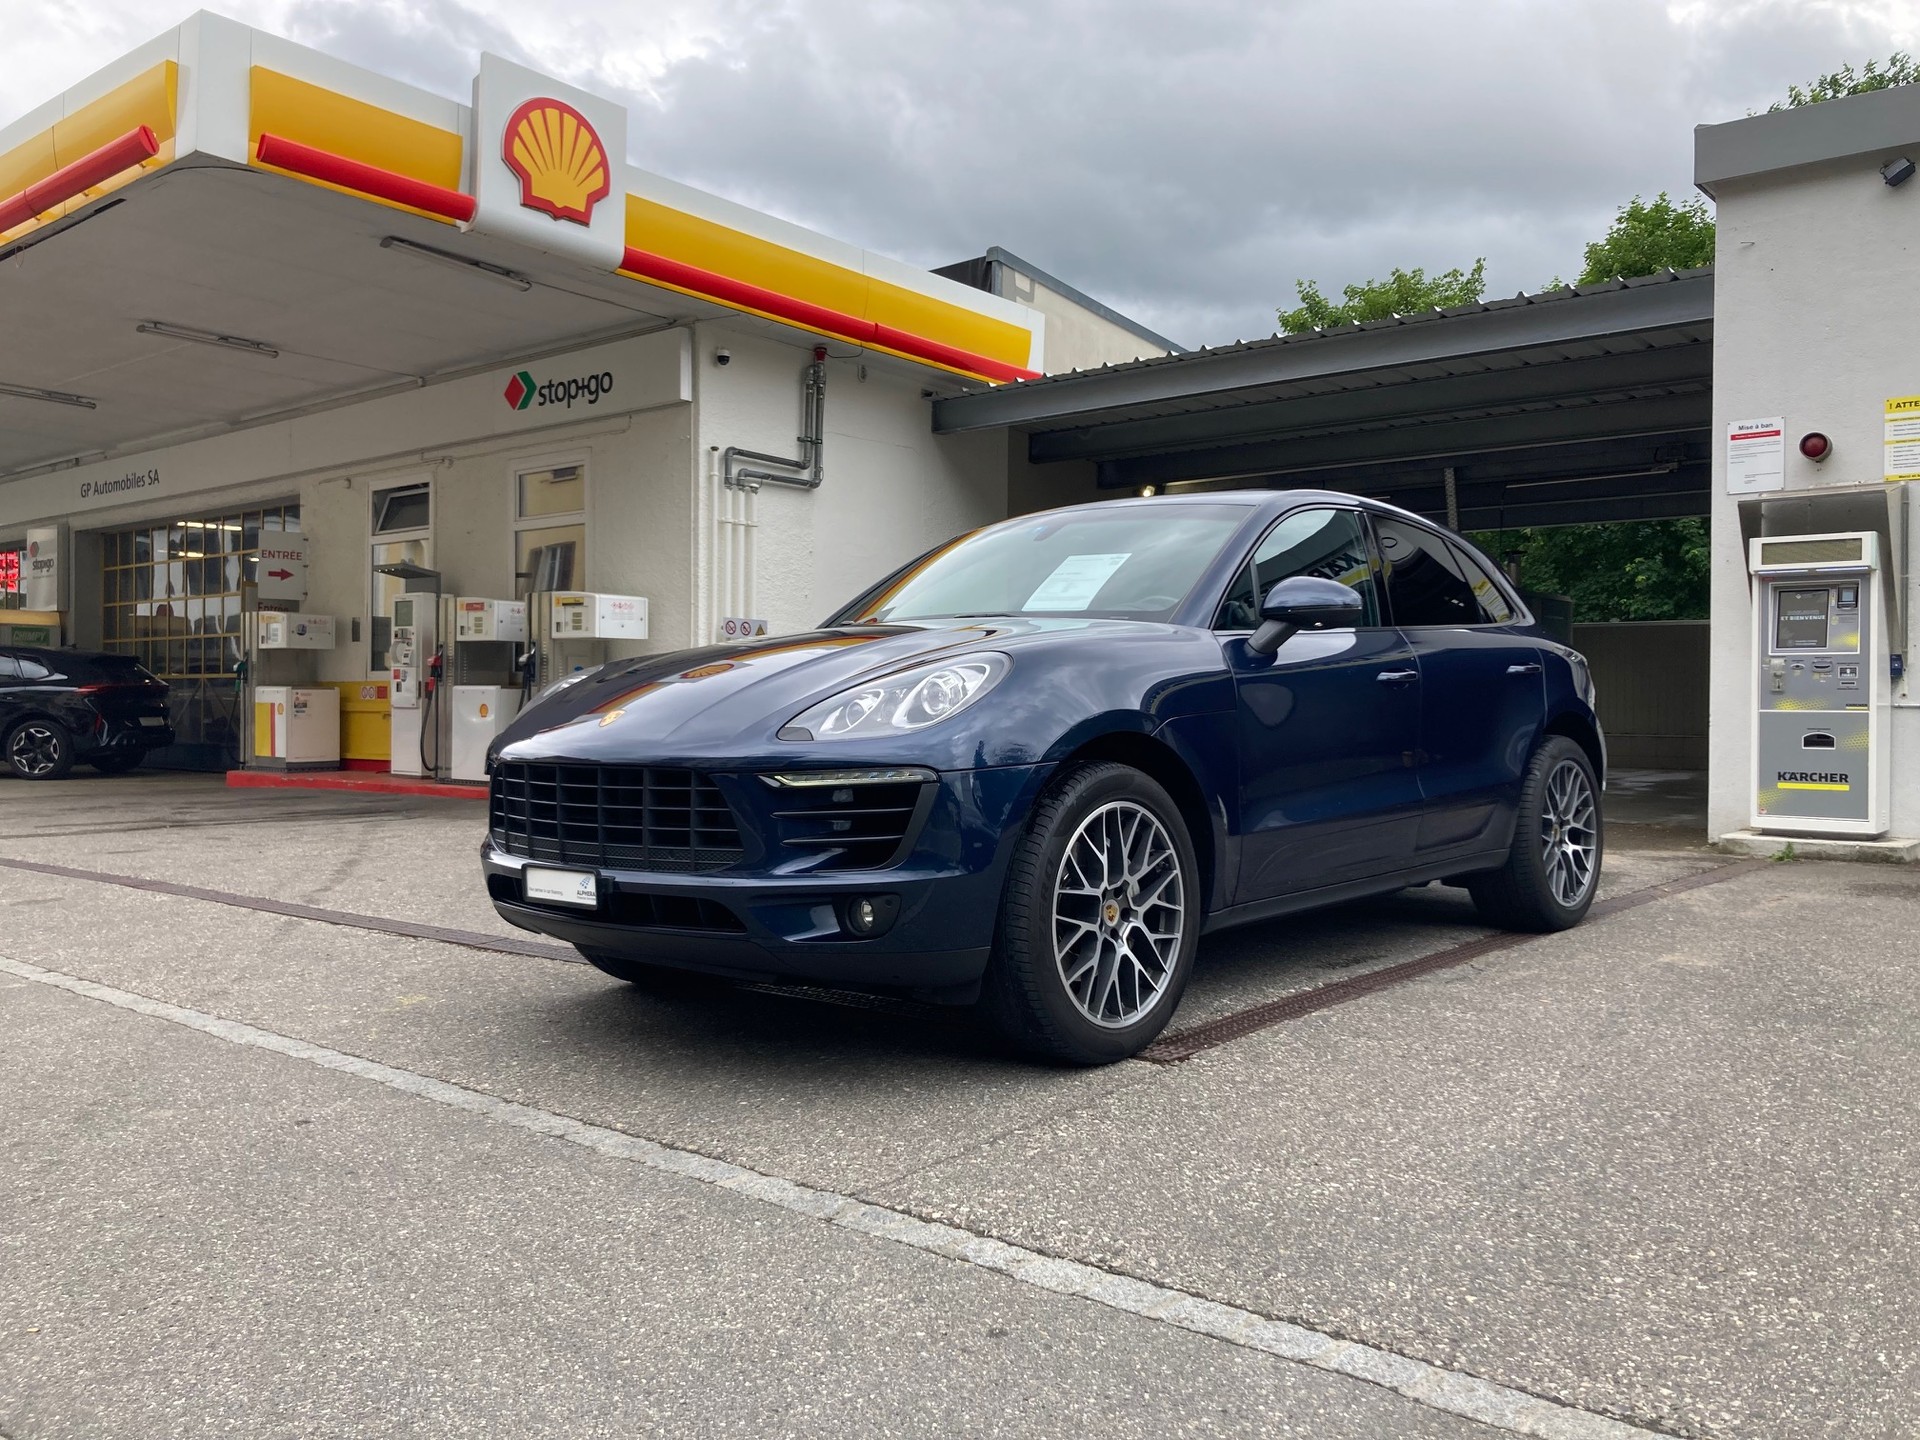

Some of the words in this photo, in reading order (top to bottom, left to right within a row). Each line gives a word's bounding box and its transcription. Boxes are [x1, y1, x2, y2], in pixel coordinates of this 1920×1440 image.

[538, 371, 613, 408] stop+go
[80, 482, 91, 498] GP
[93, 472, 146, 496] Automobiles
[147, 468, 160, 486] SA
[261, 549, 302, 561] ENTRÉE
[1777, 771, 1849, 783] KÄRCHER
